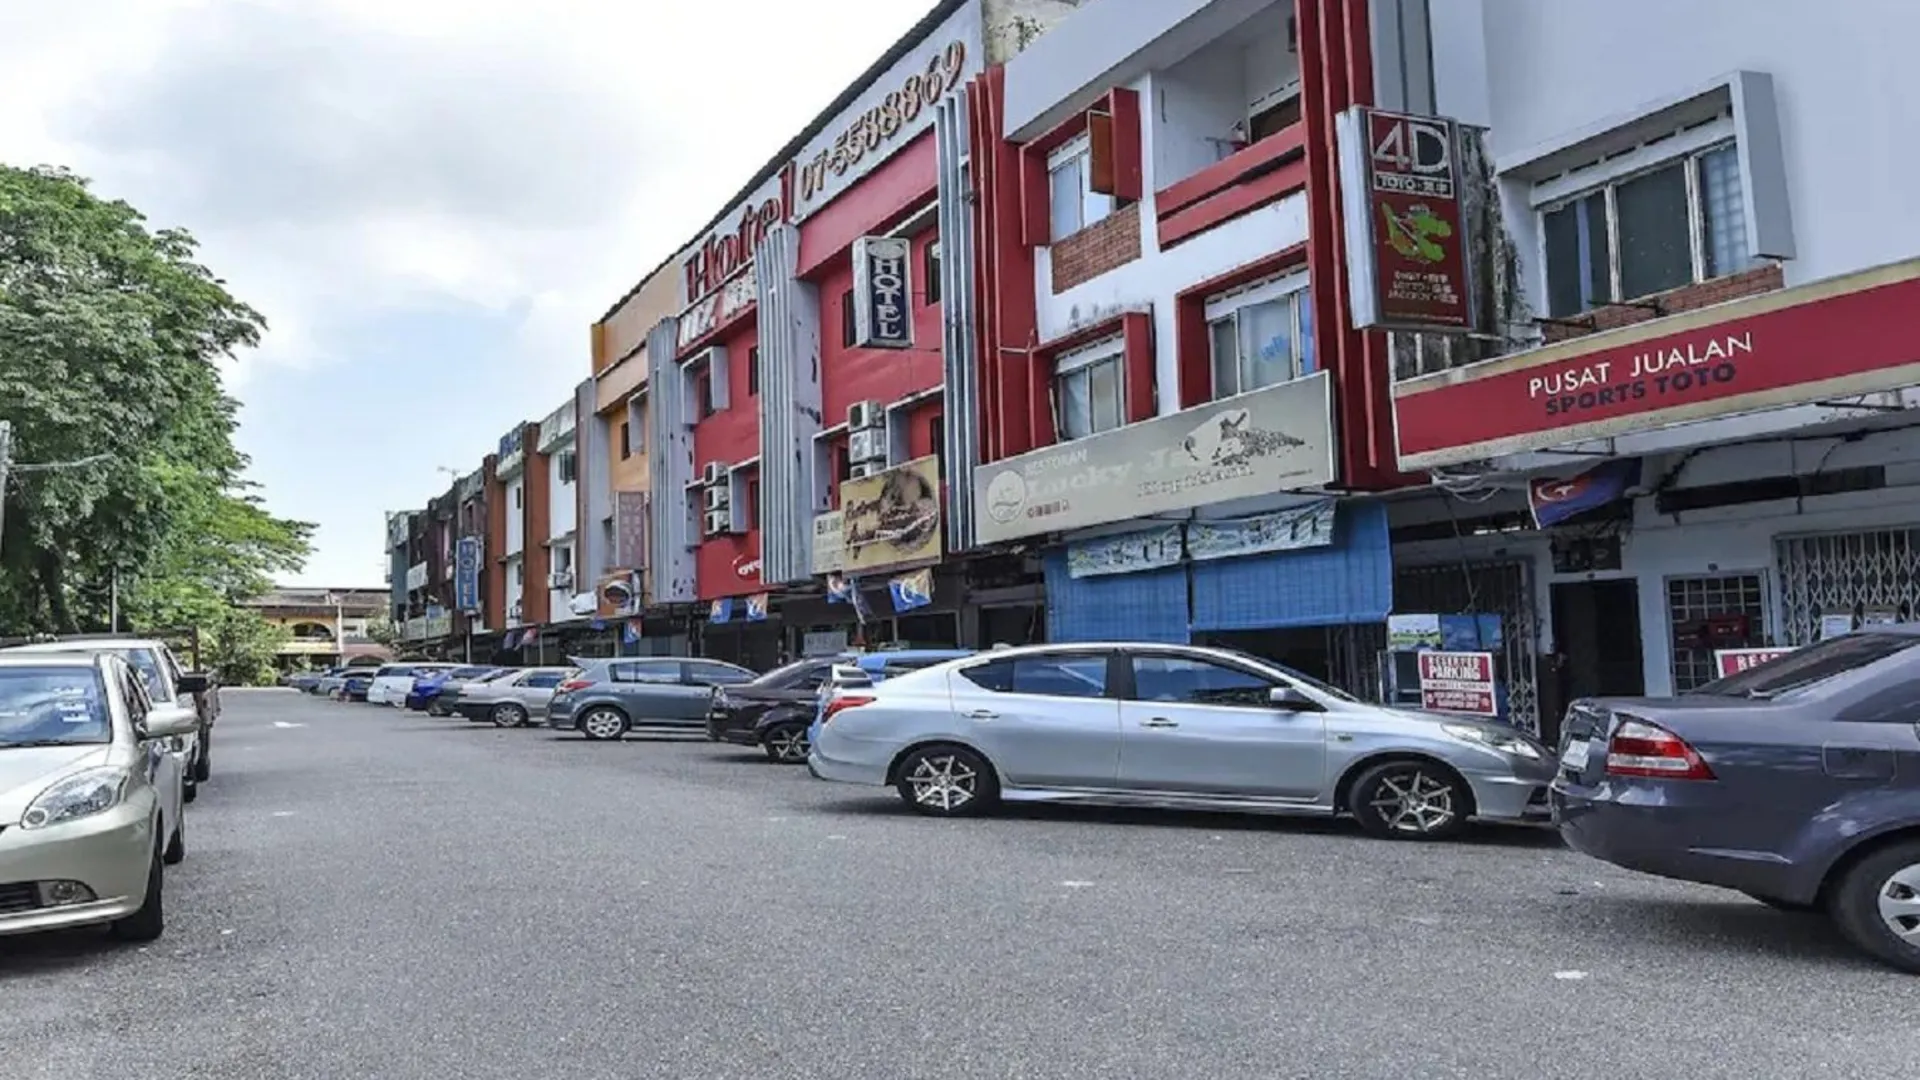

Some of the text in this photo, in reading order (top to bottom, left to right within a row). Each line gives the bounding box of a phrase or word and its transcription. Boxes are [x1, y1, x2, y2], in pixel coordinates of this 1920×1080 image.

[801, 40, 965, 201] 07-5588869
[1374, 120, 1449, 173] 4D
[1377, 175, 1416, 190] TOTO
[684, 160, 797, 303] Hotel
[872, 259, 902, 338] HOTEL
[1529, 331, 1752, 398] PUSAT JUALAN
[1545, 362, 1737, 416] SPORTS TOTO
[1427, 665, 1481, 680] PARKING
